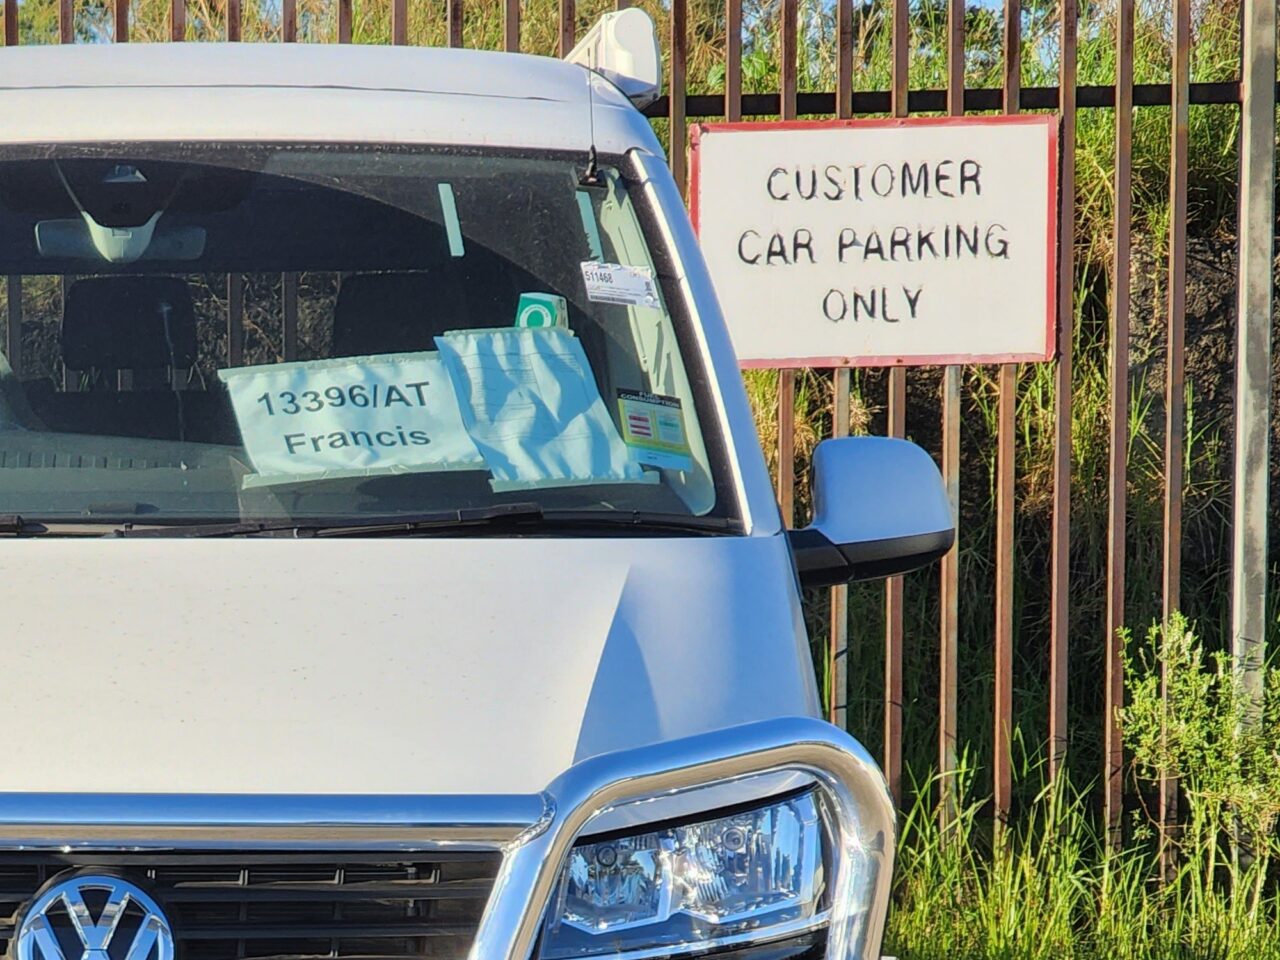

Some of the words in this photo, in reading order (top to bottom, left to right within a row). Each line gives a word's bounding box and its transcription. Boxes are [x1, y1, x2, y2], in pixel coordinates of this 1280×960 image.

[767, 159, 982, 201] CUSTOMER
[738, 229, 817, 265] CAR
[838, 223, 1010, 264] PARKING
[822, 286, 923, 322] ONLY
[257, 381, 431, 416] 13396/AT
[284, 426, 431, 455] Francis
